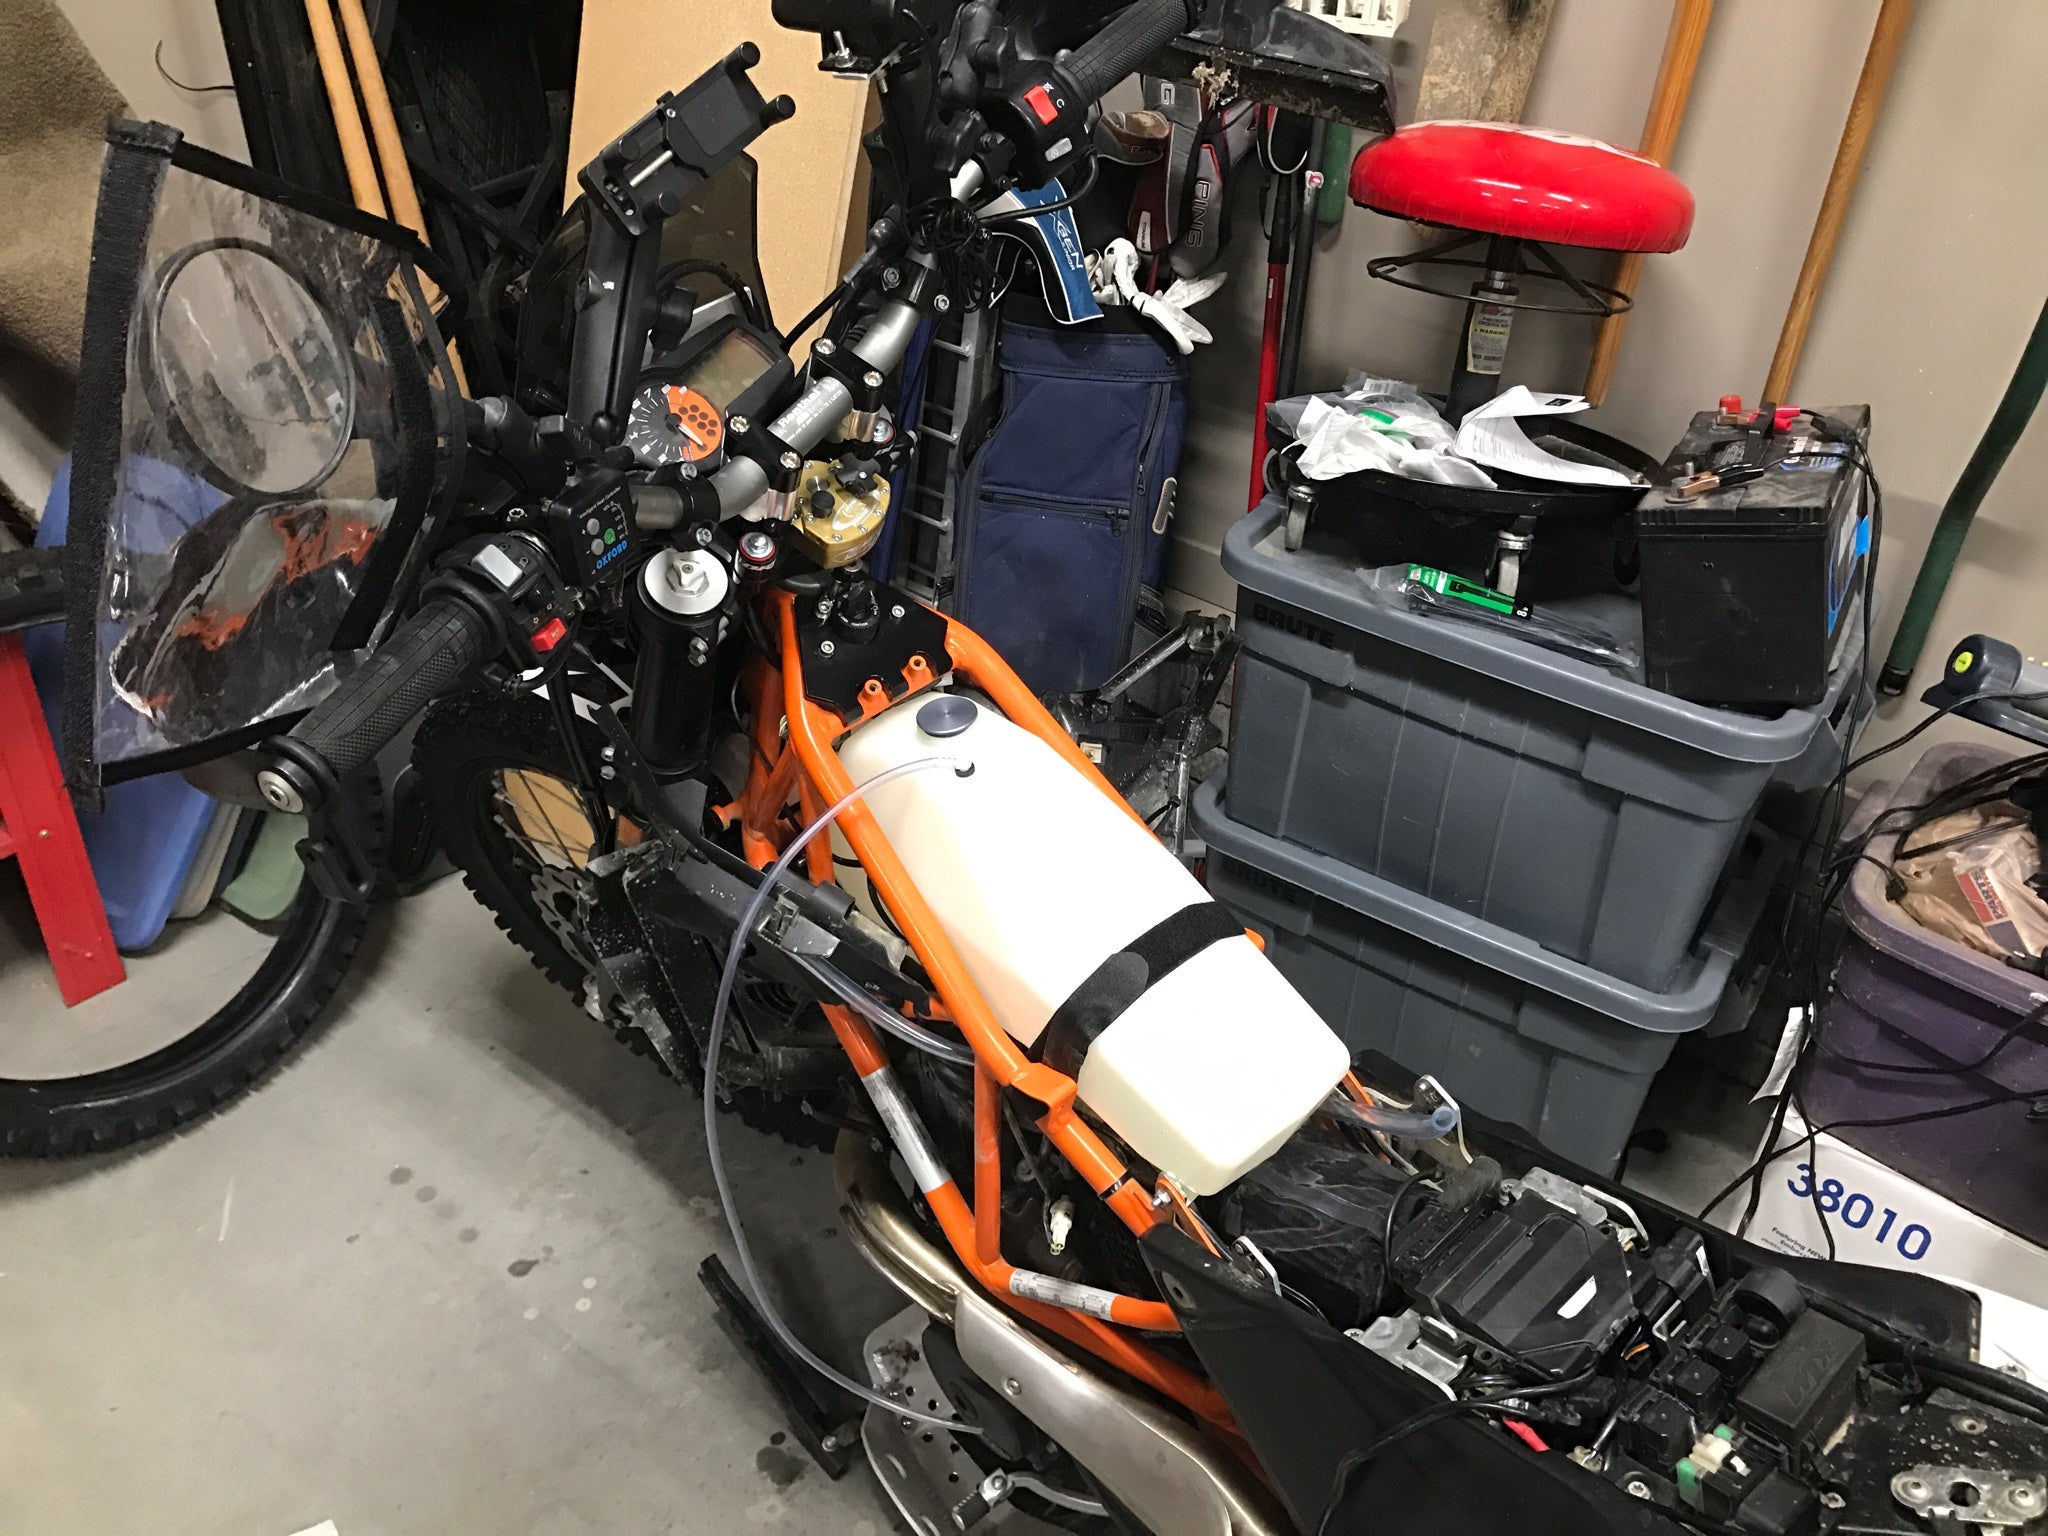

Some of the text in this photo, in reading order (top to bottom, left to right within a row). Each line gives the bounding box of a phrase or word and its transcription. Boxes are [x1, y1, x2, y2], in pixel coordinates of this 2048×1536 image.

[1186, 179, 1211, 249] PING
[776, 388, 821, 428] Renthal
[596, 540, 628, 570] OXFORD
[1252, 602, 1335, 651] BRUTE
[1970, 870, 2004, 920] PARTS
[1787, 1163, 1932, 1261] 38010
